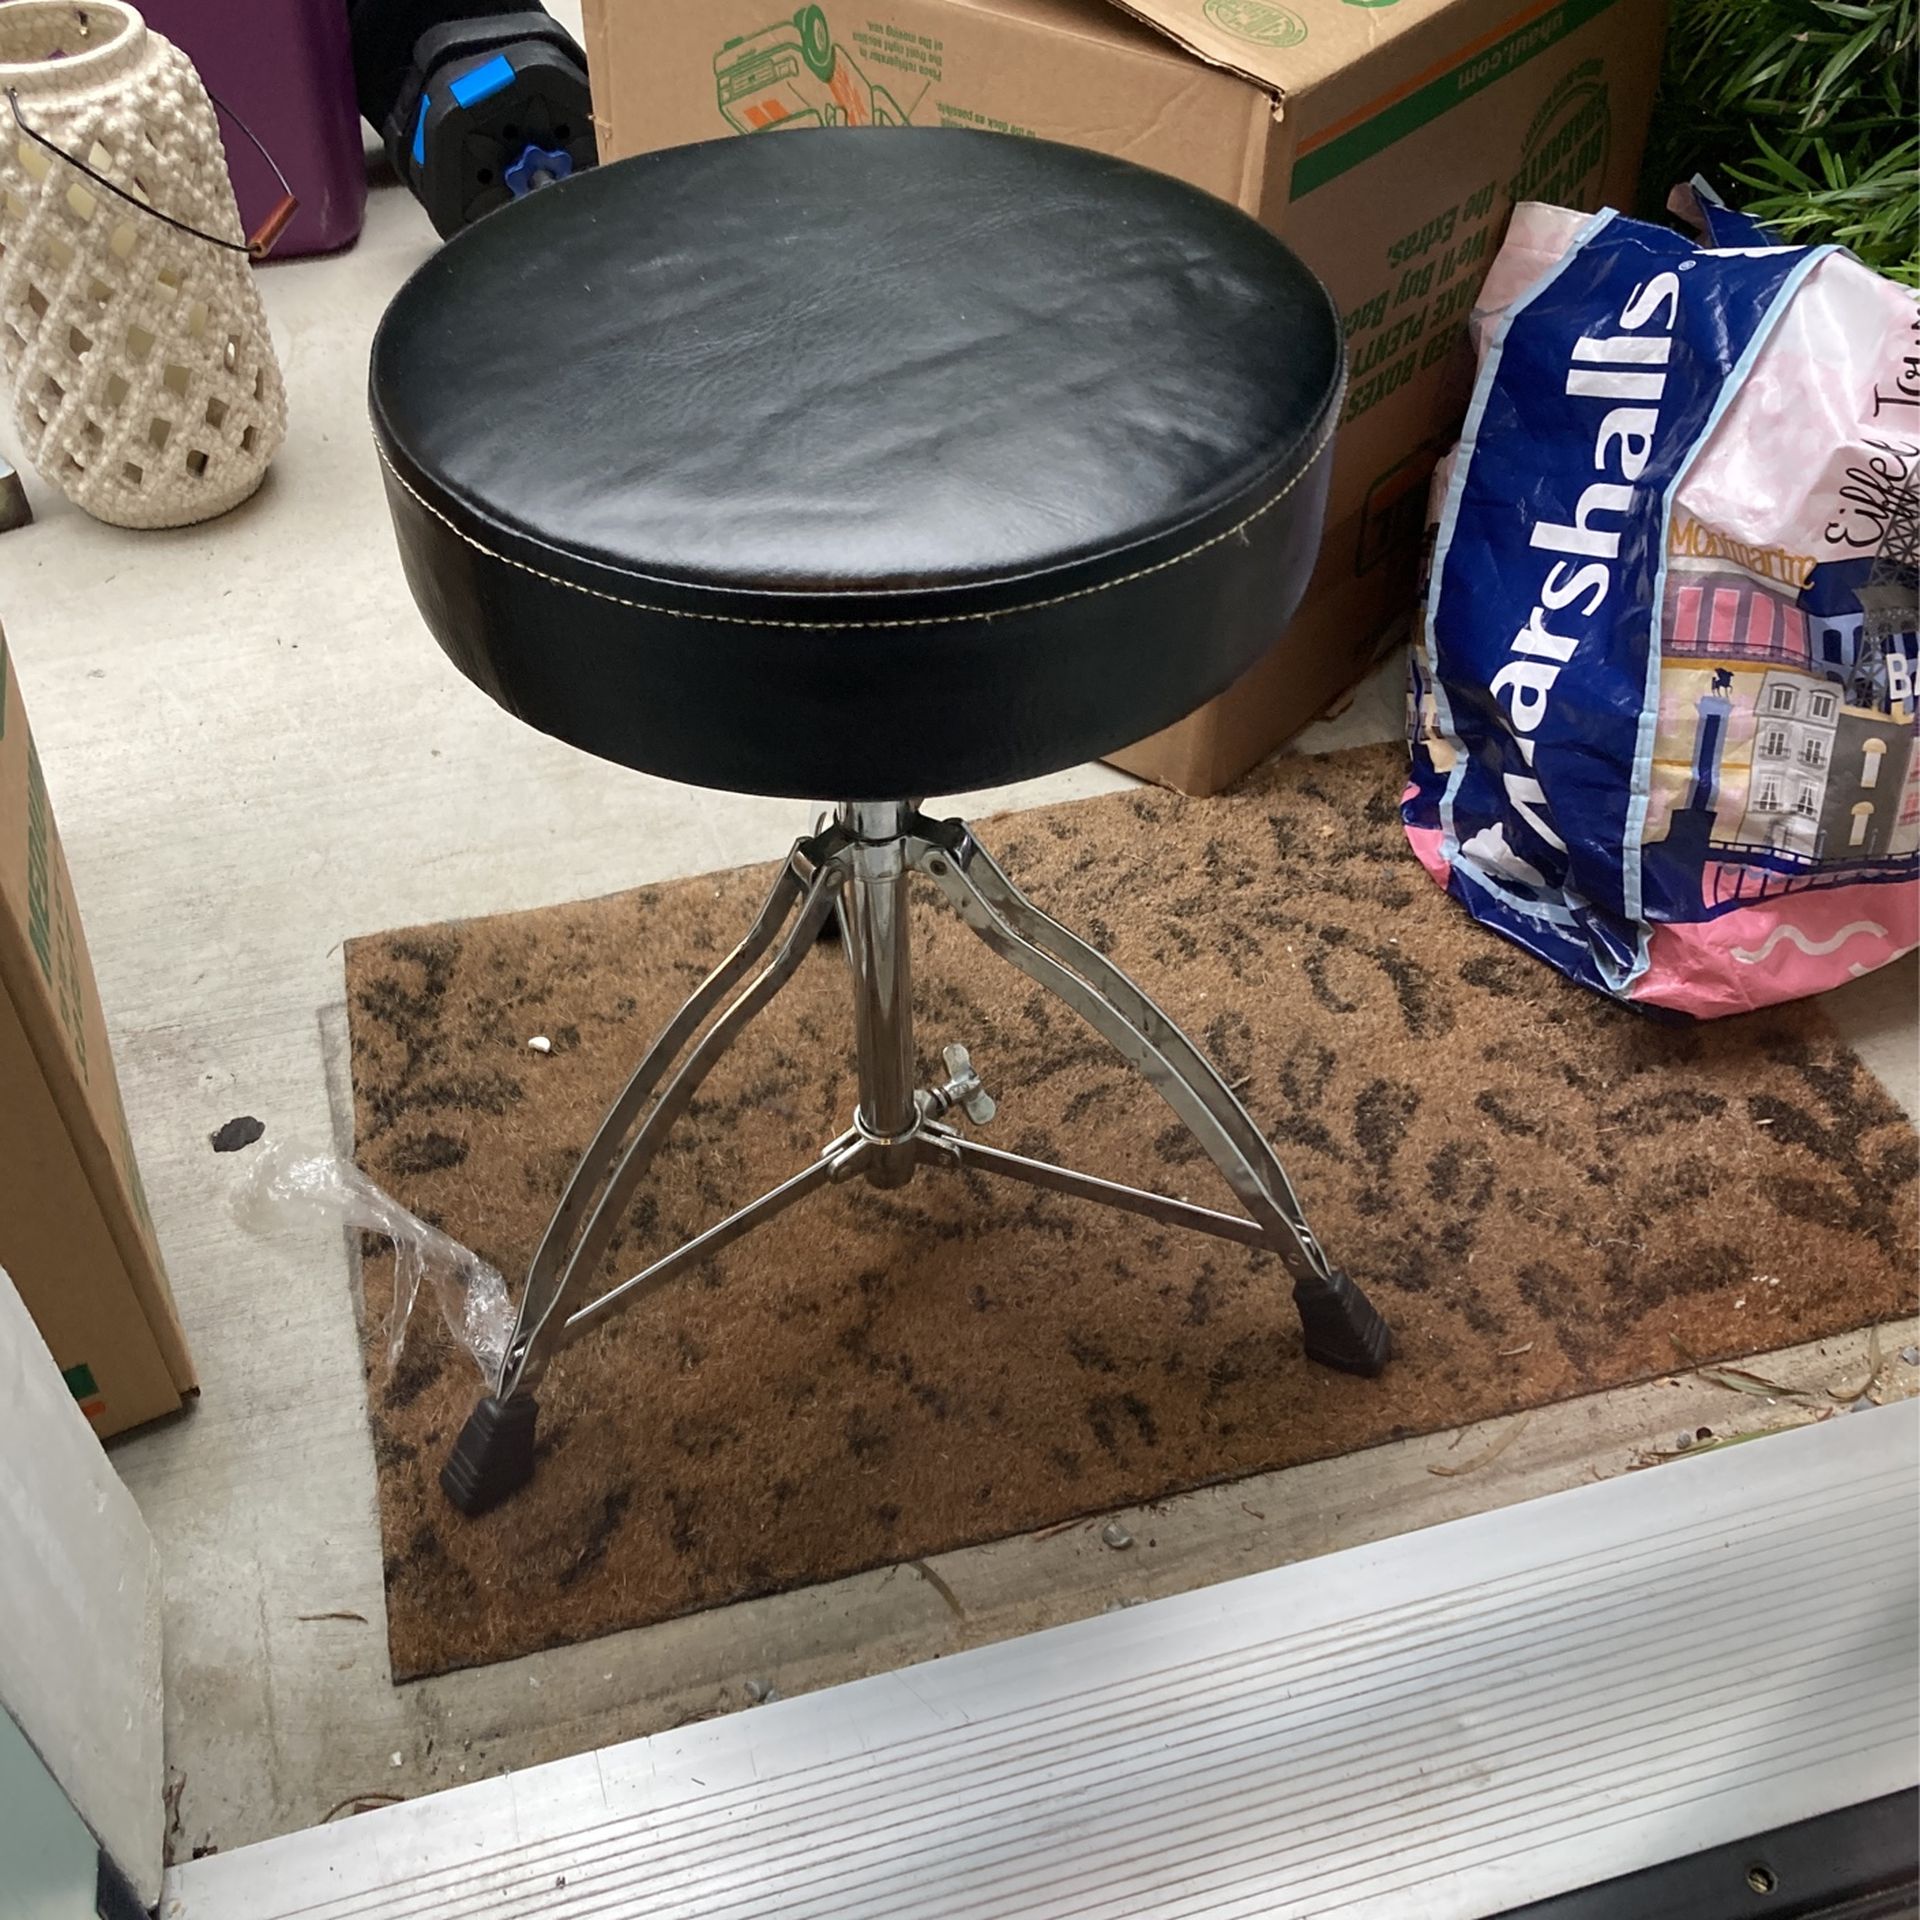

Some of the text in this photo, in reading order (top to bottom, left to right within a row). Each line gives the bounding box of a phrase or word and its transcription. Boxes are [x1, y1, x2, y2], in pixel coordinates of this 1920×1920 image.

[1393, 261, 1436, 309] Buy
[1344, 289, 1390, 339] Bac
[1885, 652, 1920, 700] B
